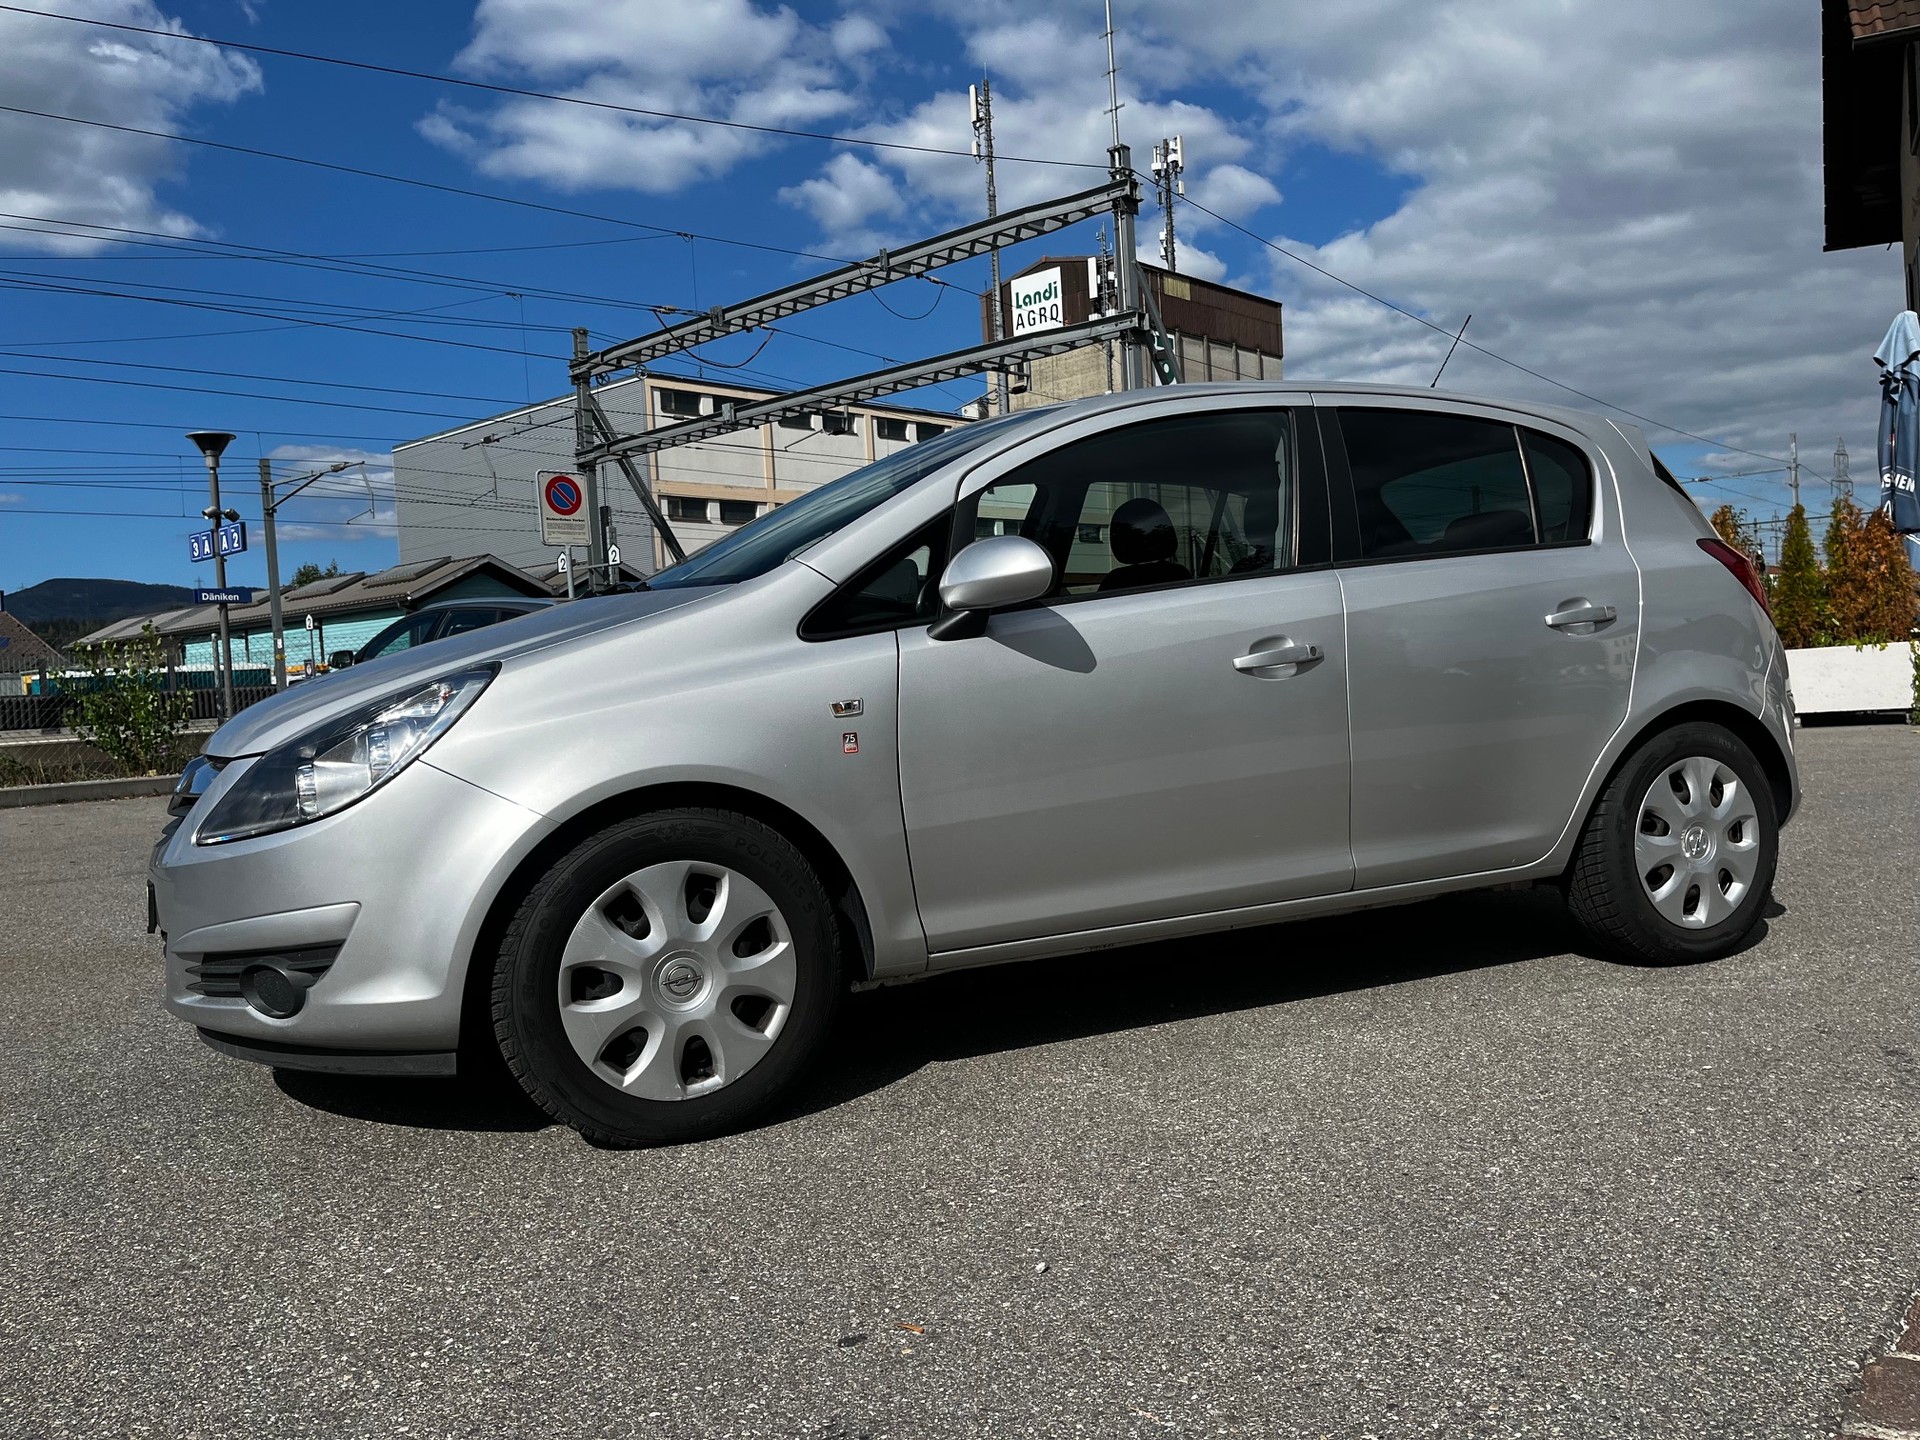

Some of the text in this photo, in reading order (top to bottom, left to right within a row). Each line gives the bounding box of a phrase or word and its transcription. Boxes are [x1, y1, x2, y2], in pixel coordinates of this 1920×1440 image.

[1015, 281, 1058, 309] Landi
[1016, 303, 1059, 330] AGRO
[193, 540, 210, 557] 3 A
[222, 532, 239, 550] A 2
[560, 558, 566, 570] 2
[611, 550, 617, 562] 2
[202, 592, 240, 601] Däniken
[845, 734, 856, 744] 75
[734, 836, 806, 898] POLARIS
